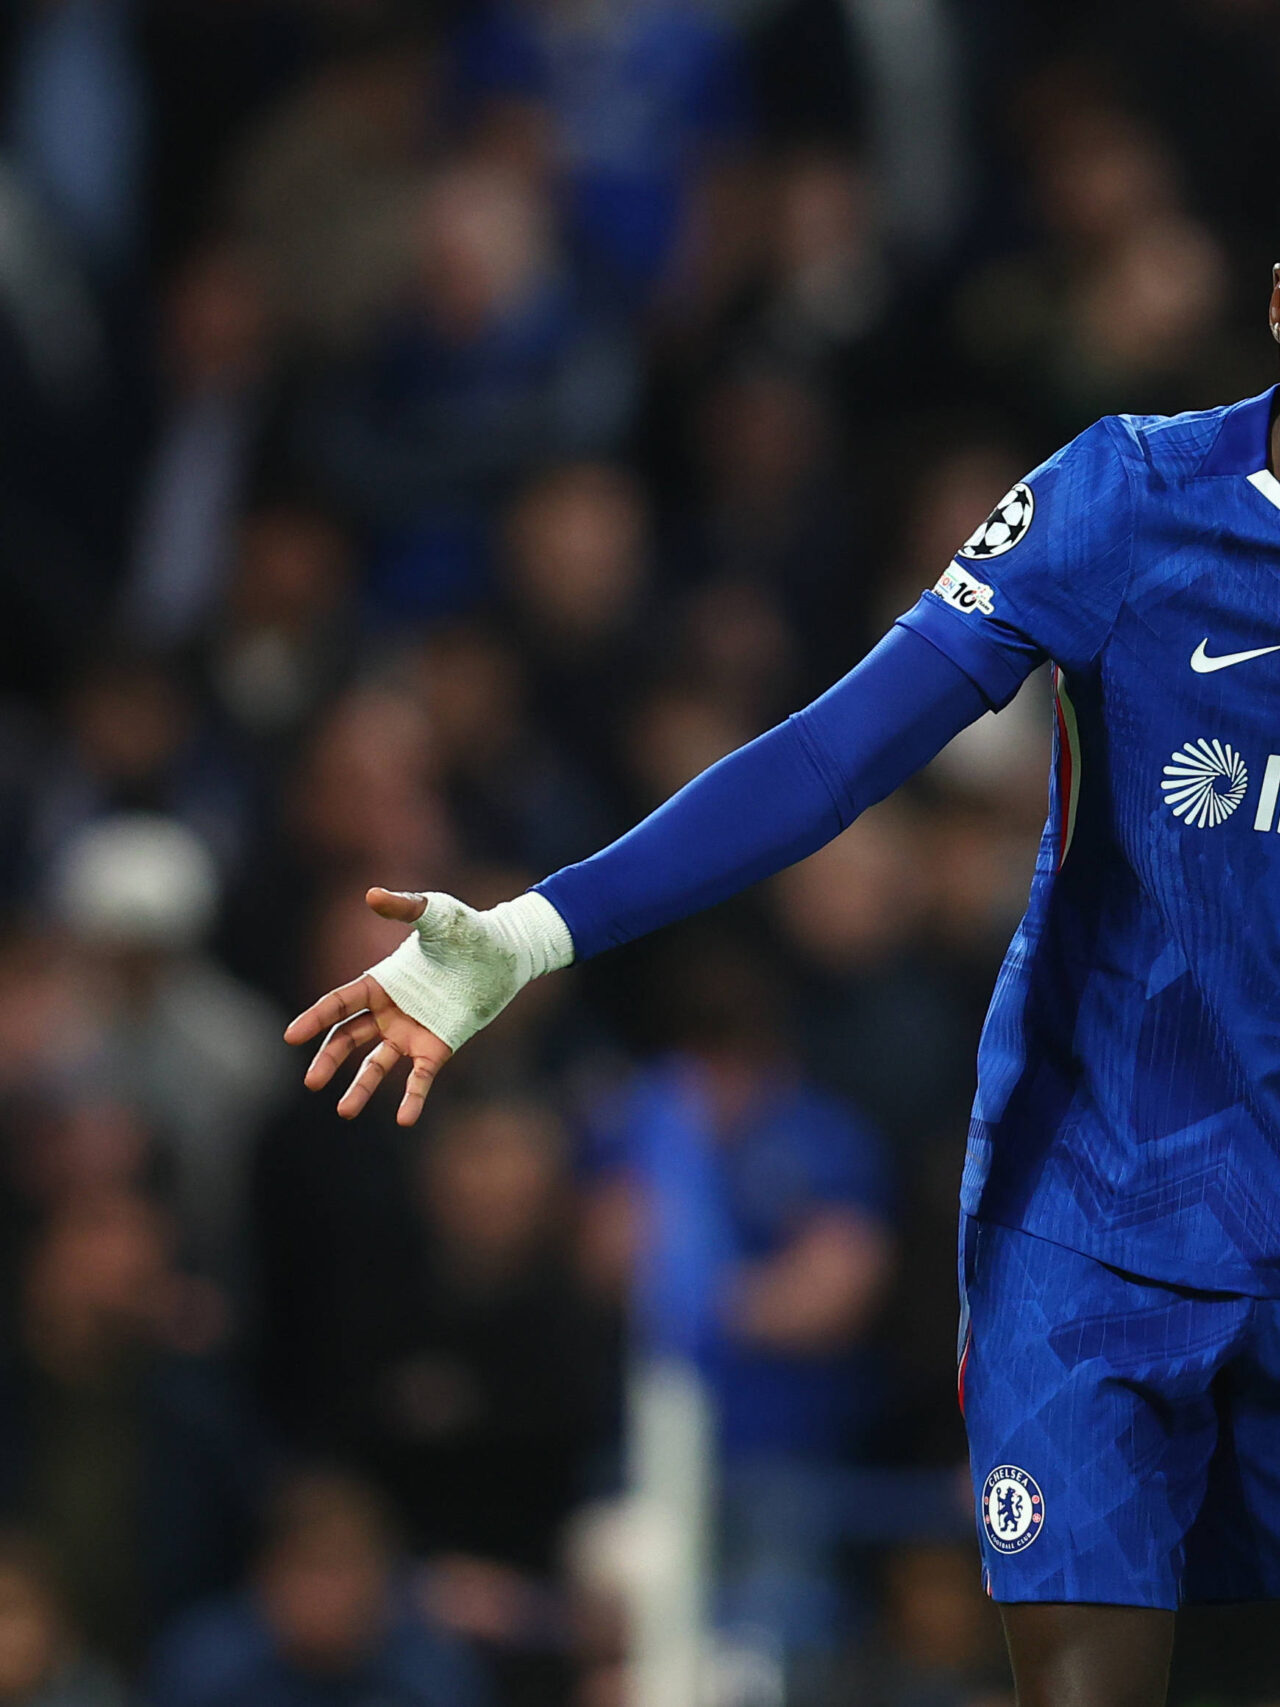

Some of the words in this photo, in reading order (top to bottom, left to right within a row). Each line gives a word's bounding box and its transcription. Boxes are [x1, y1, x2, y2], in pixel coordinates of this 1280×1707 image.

[988, 1468, 1029, 1488] CHELSEA
[990, 1533, 1016, 1550] FOOTBALL
[1016, 1532, 1032, 1547] CLUB
